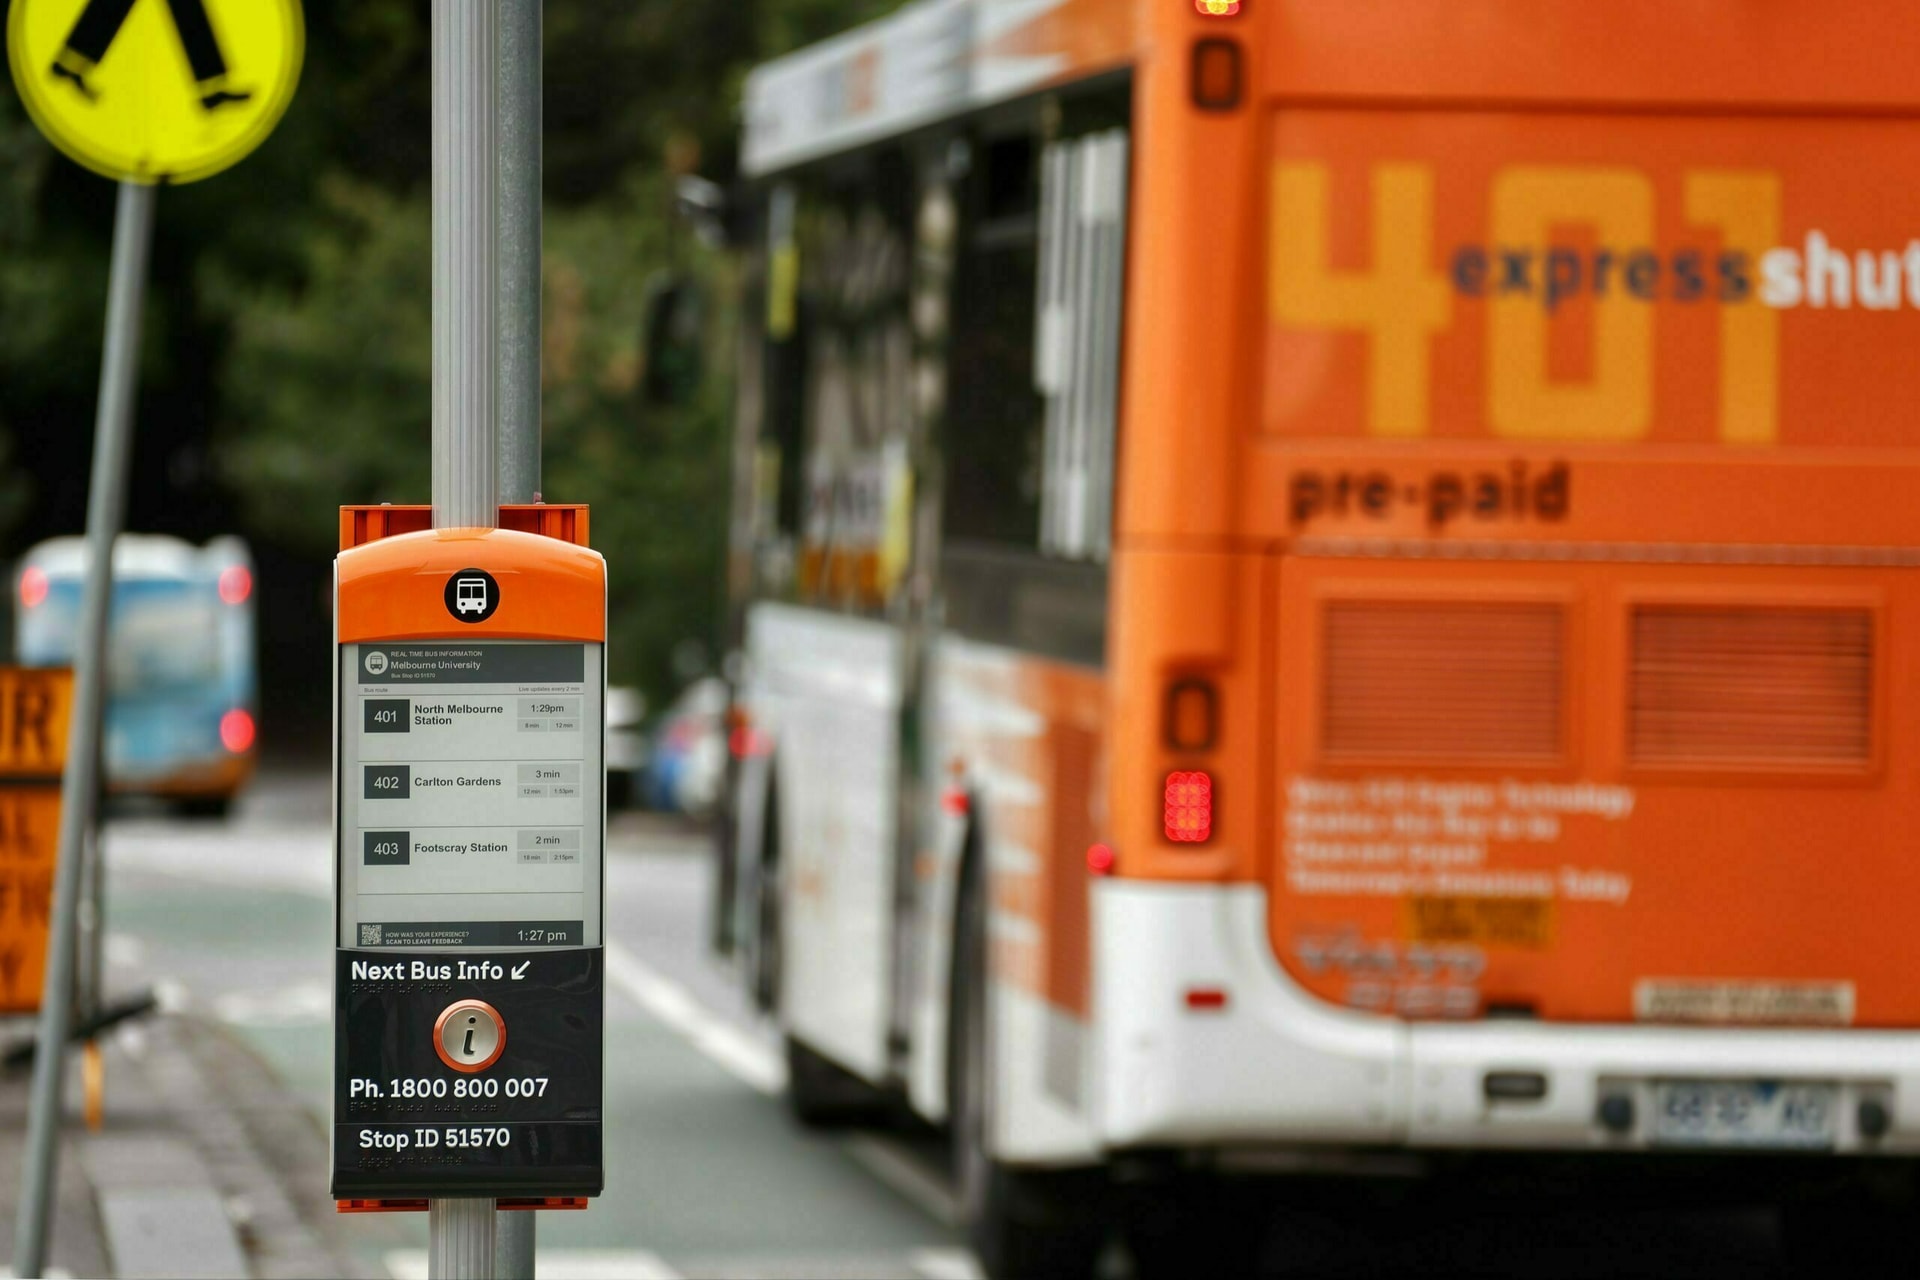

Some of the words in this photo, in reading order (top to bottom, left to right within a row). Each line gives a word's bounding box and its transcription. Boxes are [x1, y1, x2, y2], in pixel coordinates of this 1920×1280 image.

[1271, 161, 1780, 443] 401
[1288, 461, 1571, 530] pre-paid
[390, 661, 437, 670] Melbourne
[438, 661, 481, 671] University
[414, 705, 444, 714] North
[447, 705, 503, 714] Melbourne
[531, 704, 564, 714] 1:29pm
[374, 710, 397, 722] 401
[414, 716, 452, 725] Station
[535, 770, 541, 778] 3
[543, 769, 560, 778] min
[374, 776, 399, 789] 402
[414, 777, 453, 787] Carlton
[456, 777, 502, 786] Gardens
[535, 836, 541, 844] 2
[543, 836, 560, 844] min
[374, 842, 399, 855] 403
[414, 843, 468, 854] Footscray
[470, 843, 508, 852] Station
[517, 929, 544, 941] 1:27
[547, 930, 567, 943] pm
[351, 961, 405, 981] Next
[410, 961, 451, 981] Bus
[457, 960, 503, 981] Info
[350, 1078, 384, 1098] Ph.
[390, 1078, 447, 1098] 1800
[453, 1078, 499, 1098] 800
[505, 1078, 549, 1098] 007
[359, 1129, 409, 1153] Stop
[414, 1129, 439, 1148] ID
[445, 1128, 510, 1148] 51570
